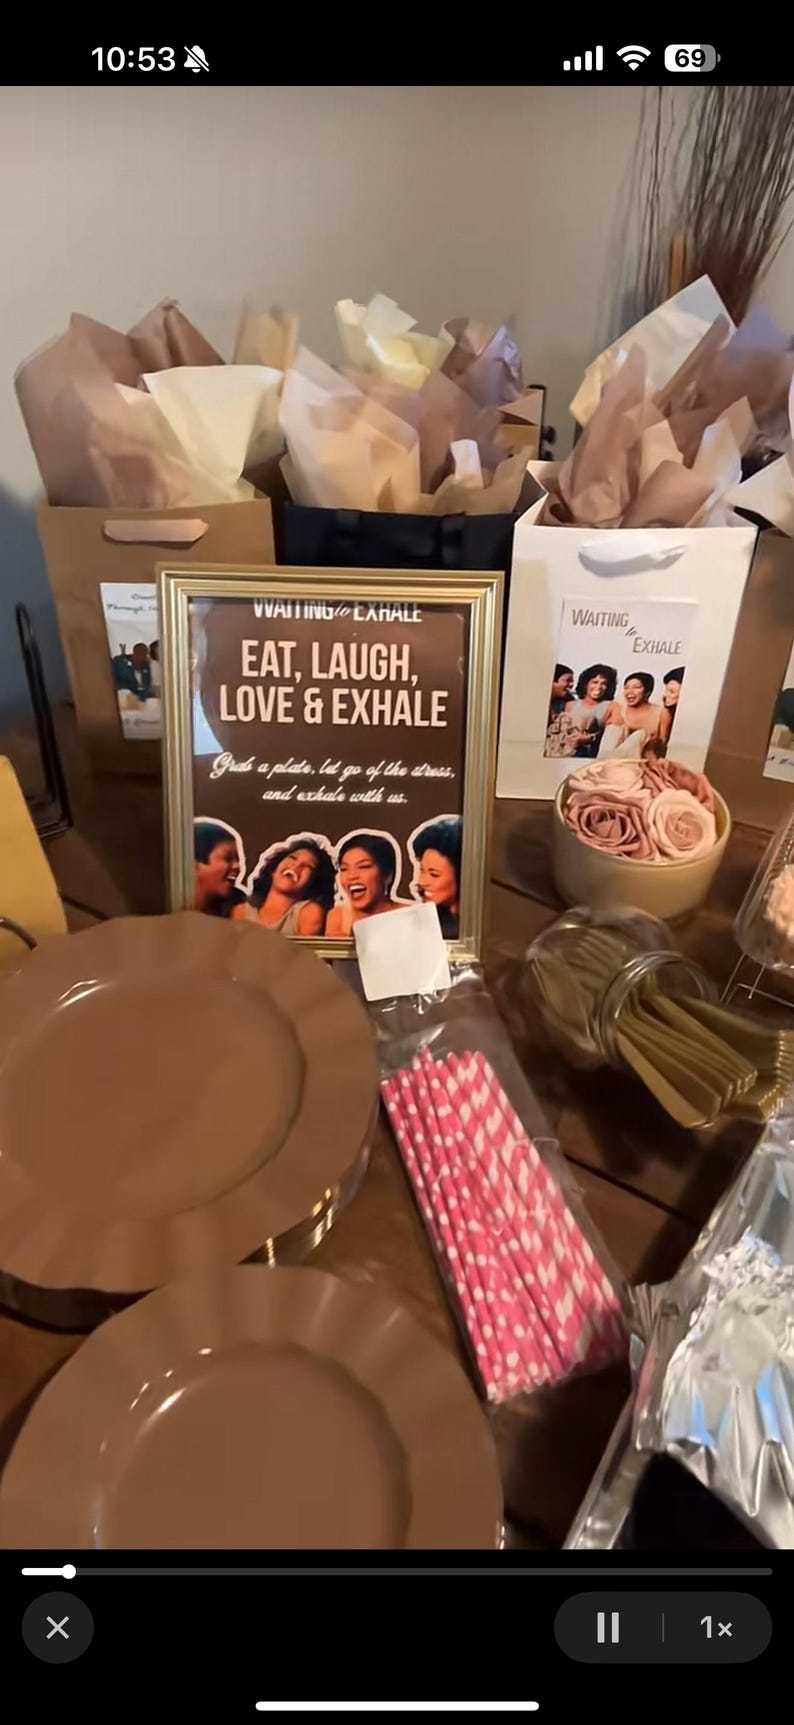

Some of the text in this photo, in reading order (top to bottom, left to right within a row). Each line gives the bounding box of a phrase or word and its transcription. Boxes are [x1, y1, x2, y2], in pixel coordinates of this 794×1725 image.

[253, 598, 334, 620] WAITING
[352, 602, 423, 623] EXHALE
[571, 608, 630, 628] WAITING
[632, 636, 682, 655] EXHALE
[241, 639, 419, 686] EAT, LAUGH,
[219, 684, 448, 727] LOVE & EXHALE
[209, 751, 456, 783] Grab a plate, let go of the stress,
[262, 784, 408, 804] and exhale with us.
